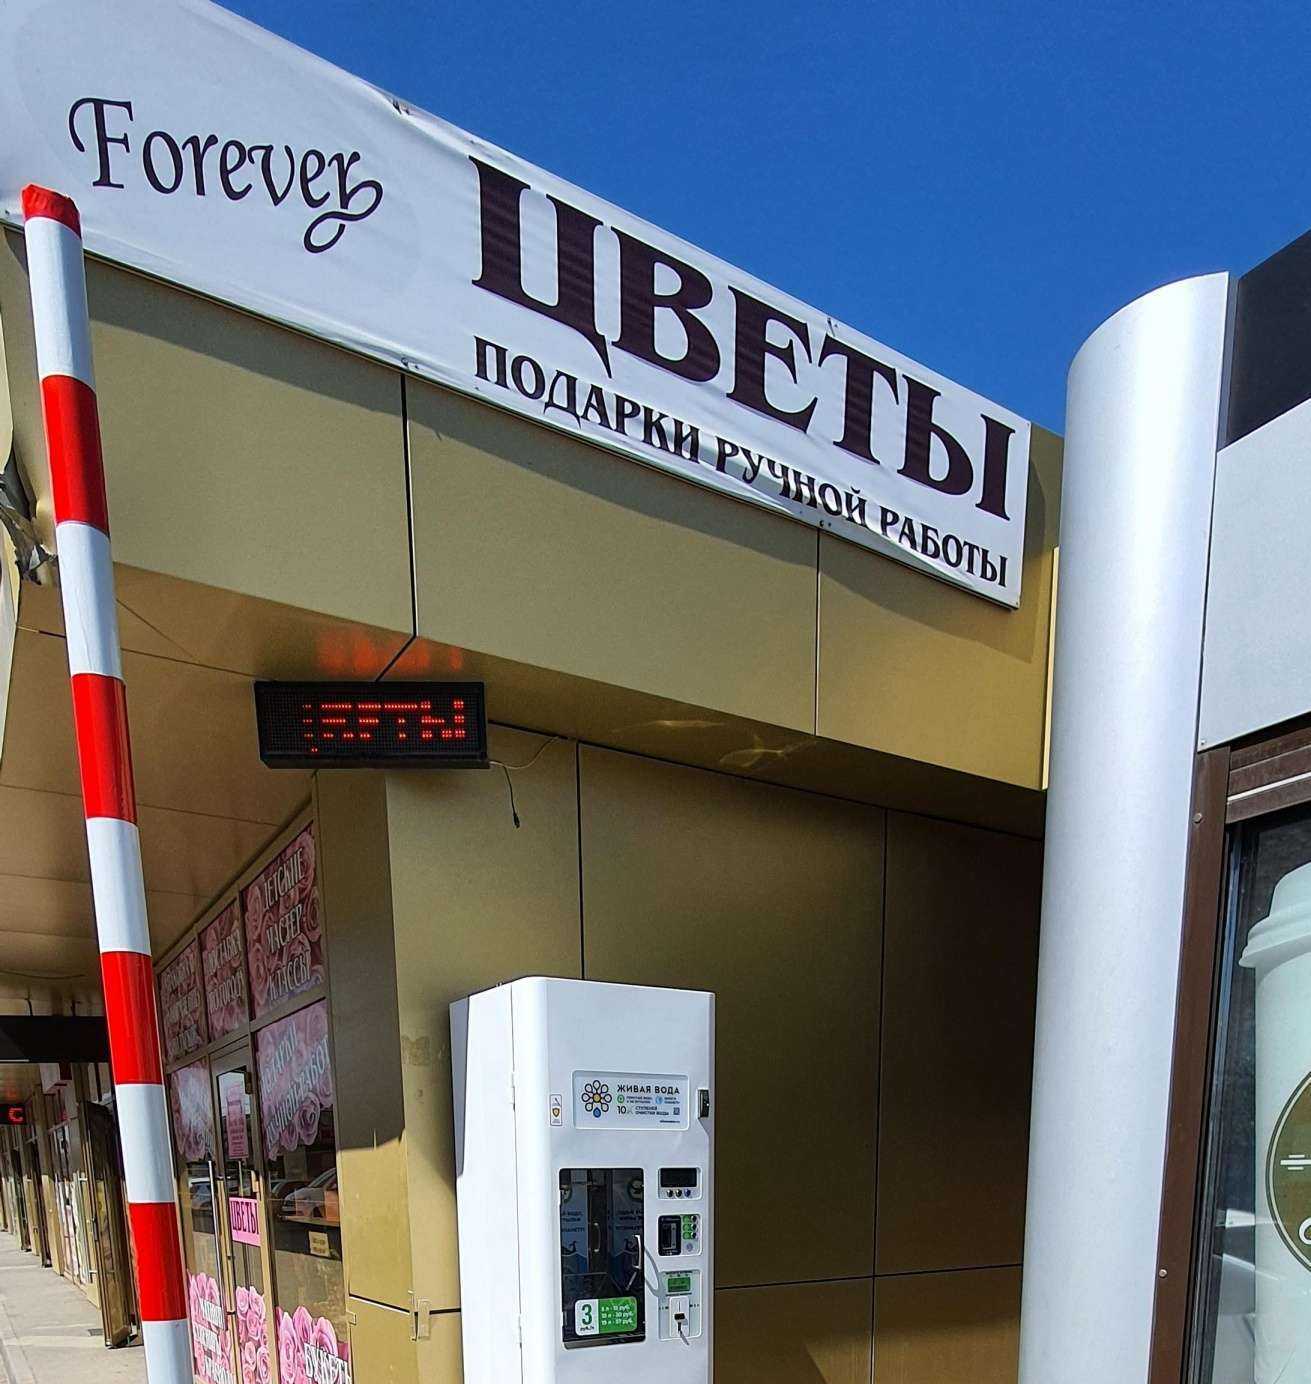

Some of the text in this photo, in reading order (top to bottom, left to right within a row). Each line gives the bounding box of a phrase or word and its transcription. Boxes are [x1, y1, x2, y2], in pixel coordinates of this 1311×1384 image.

[68, 97, 383, 253] Forever
[469, 155, 1016, 521] ЦВЕТЫ
[473, 336, 1008, 587] ПОДАРКИ РУЧНОЙ РАБОТЫ
[617, 1085, 680, 1095] ЖИВАЯ ВОДА
[231, 1198, 260, 1235] ЦВЕТЫ
[582, 1304, 593, 1325] 3
